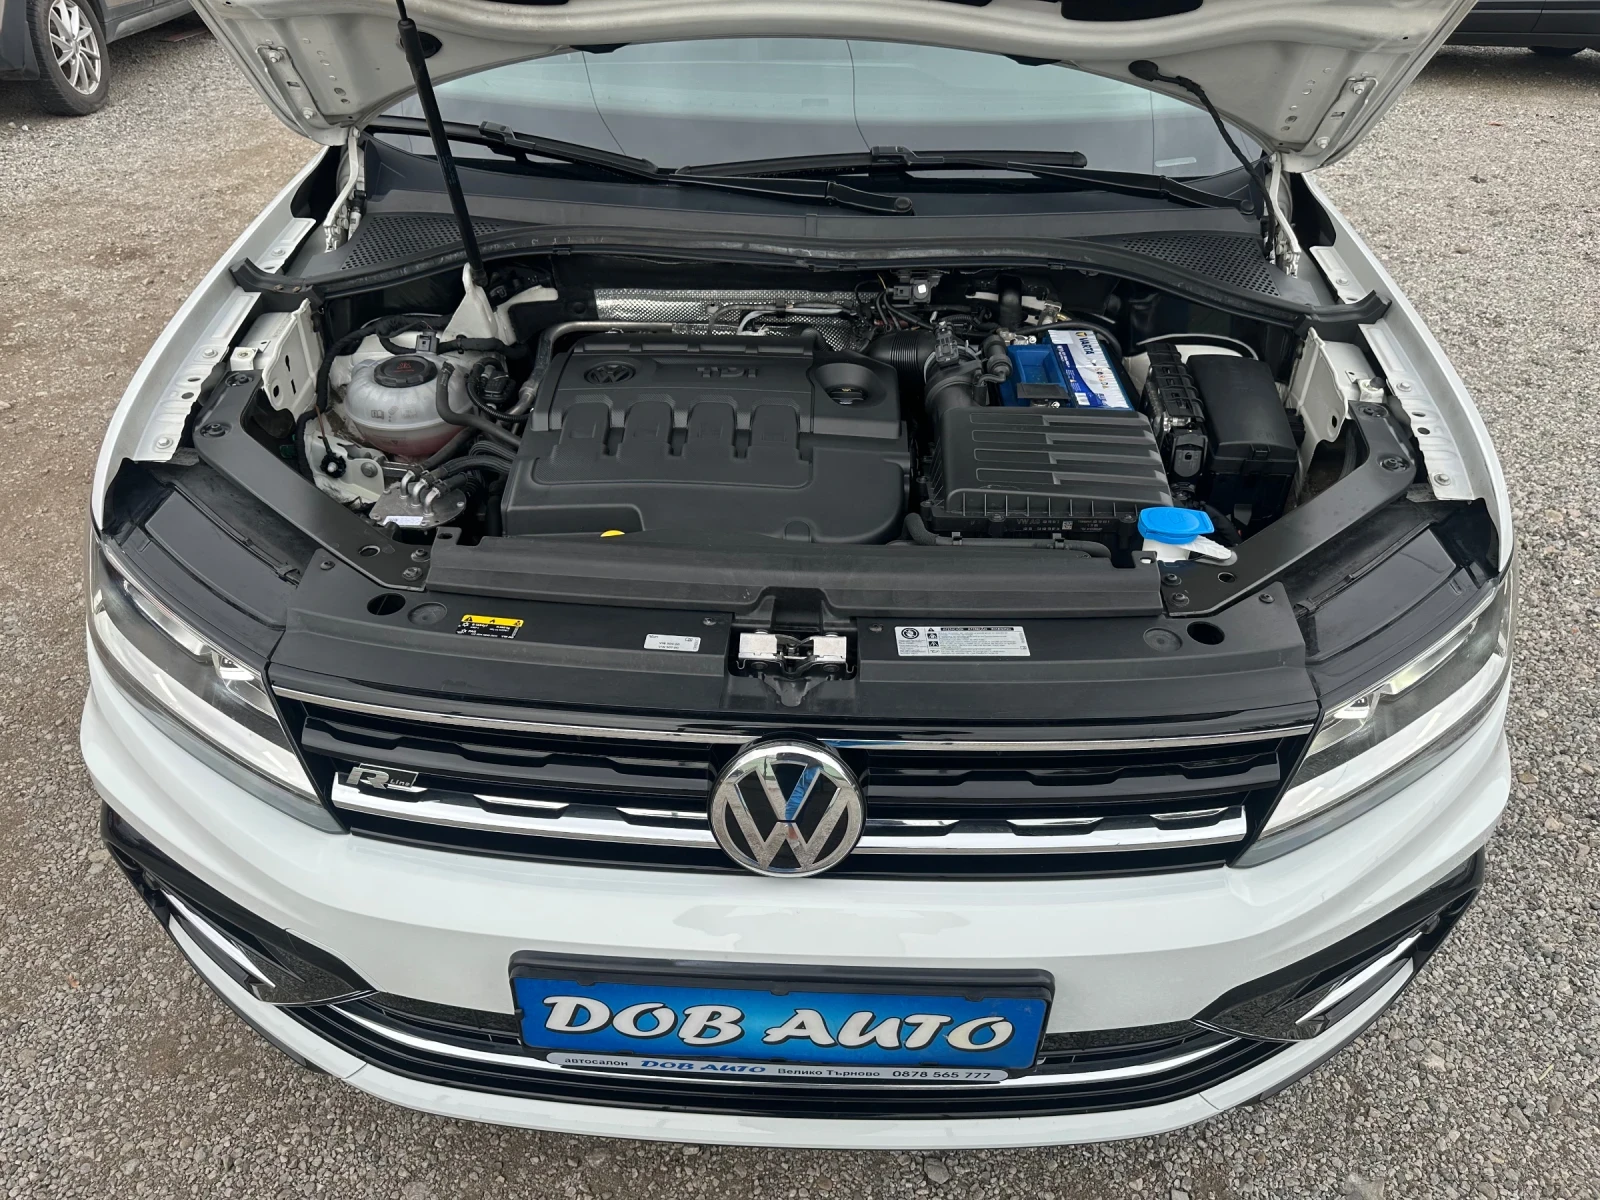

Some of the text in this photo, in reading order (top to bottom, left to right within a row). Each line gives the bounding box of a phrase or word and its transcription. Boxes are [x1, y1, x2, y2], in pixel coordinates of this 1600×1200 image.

[1078, 337, 1095, 355] VARTA
[696, 366, 758, 379] TDI
[346, 766, 390, 790] R
[714, 745, 862, 875] VW
[543, 995, 1016, 1052] DOB AUTO
[564, 1056, 629, 1067] автосалон
[640, 1060, 767, 1073] DOB AUTO
[777, 1067, 881, 1078] Велико Търново
[892, 1070, 992, 1079] 0878 565 777
